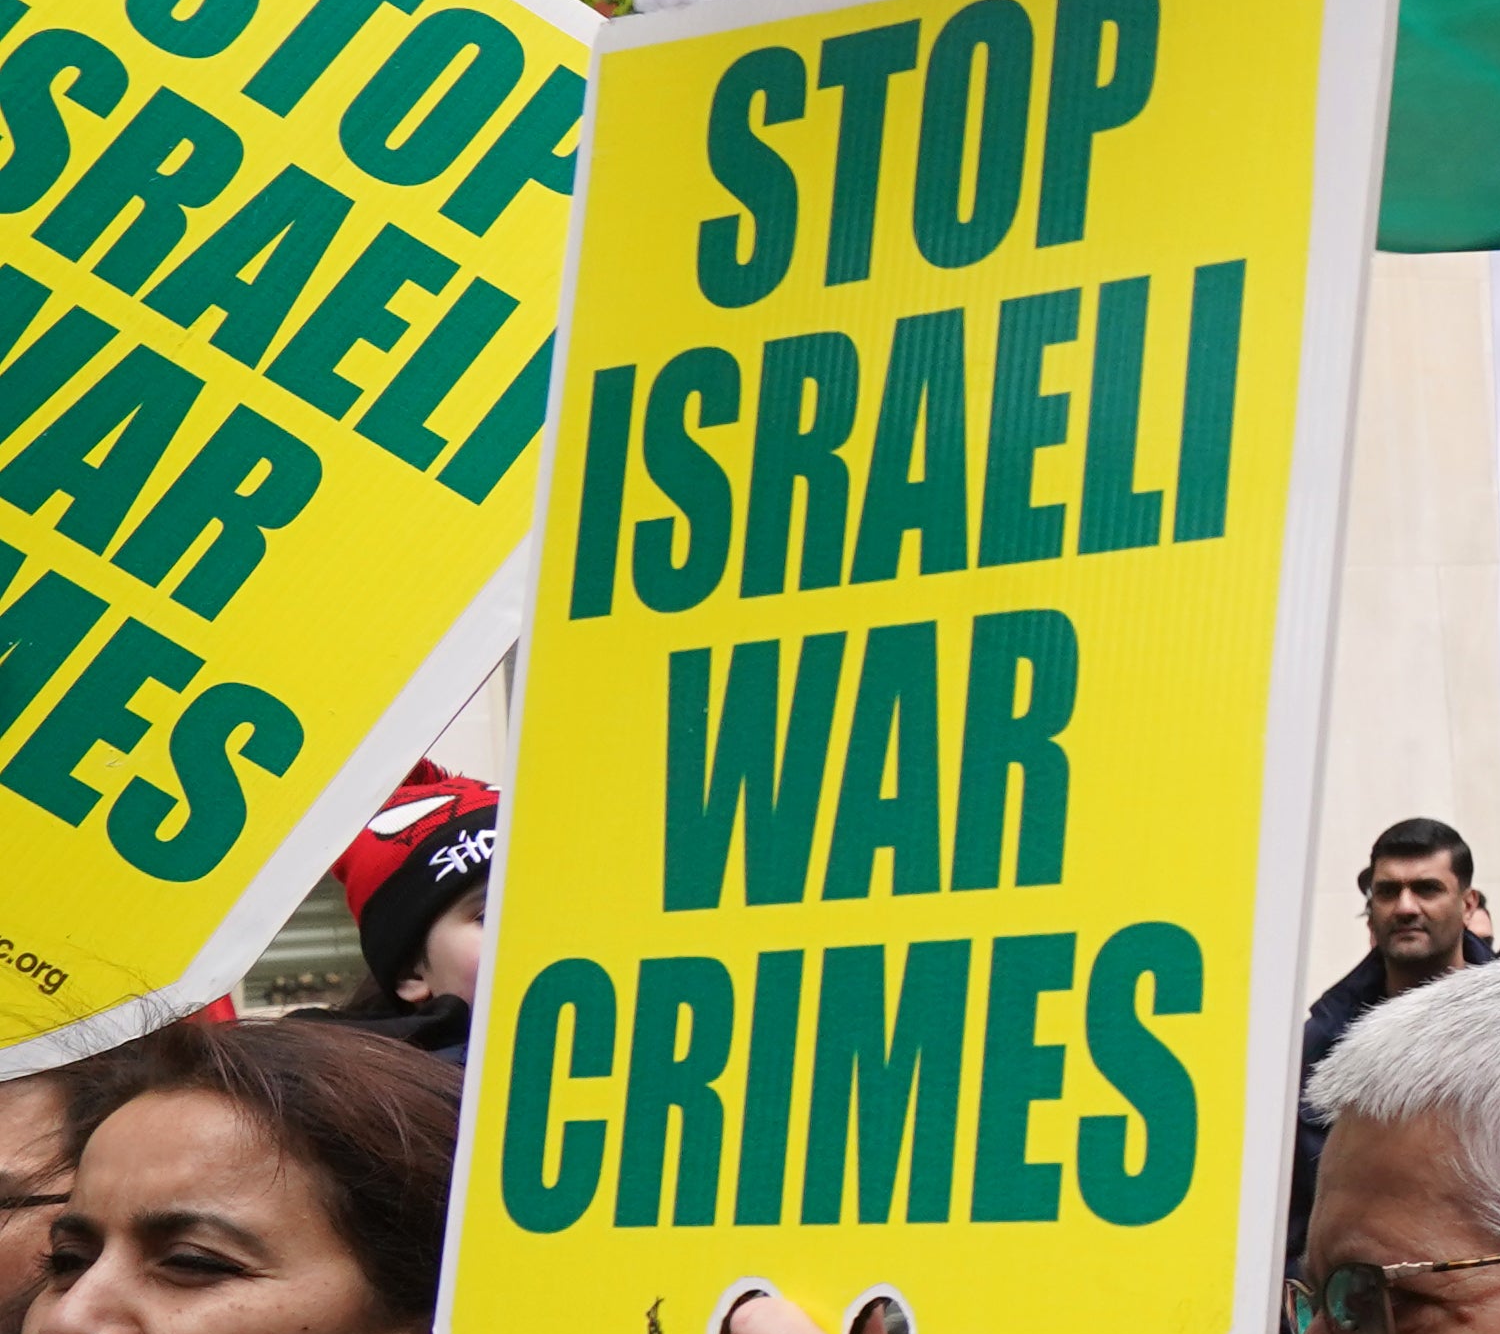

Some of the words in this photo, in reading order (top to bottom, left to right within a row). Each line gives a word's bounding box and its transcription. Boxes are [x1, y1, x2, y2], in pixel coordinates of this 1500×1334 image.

[568, 259, 1247, 620] ISRAELI
[662, 608, 1080, 912] WAR
[501, 920, 1203, 1234] CRIMES
